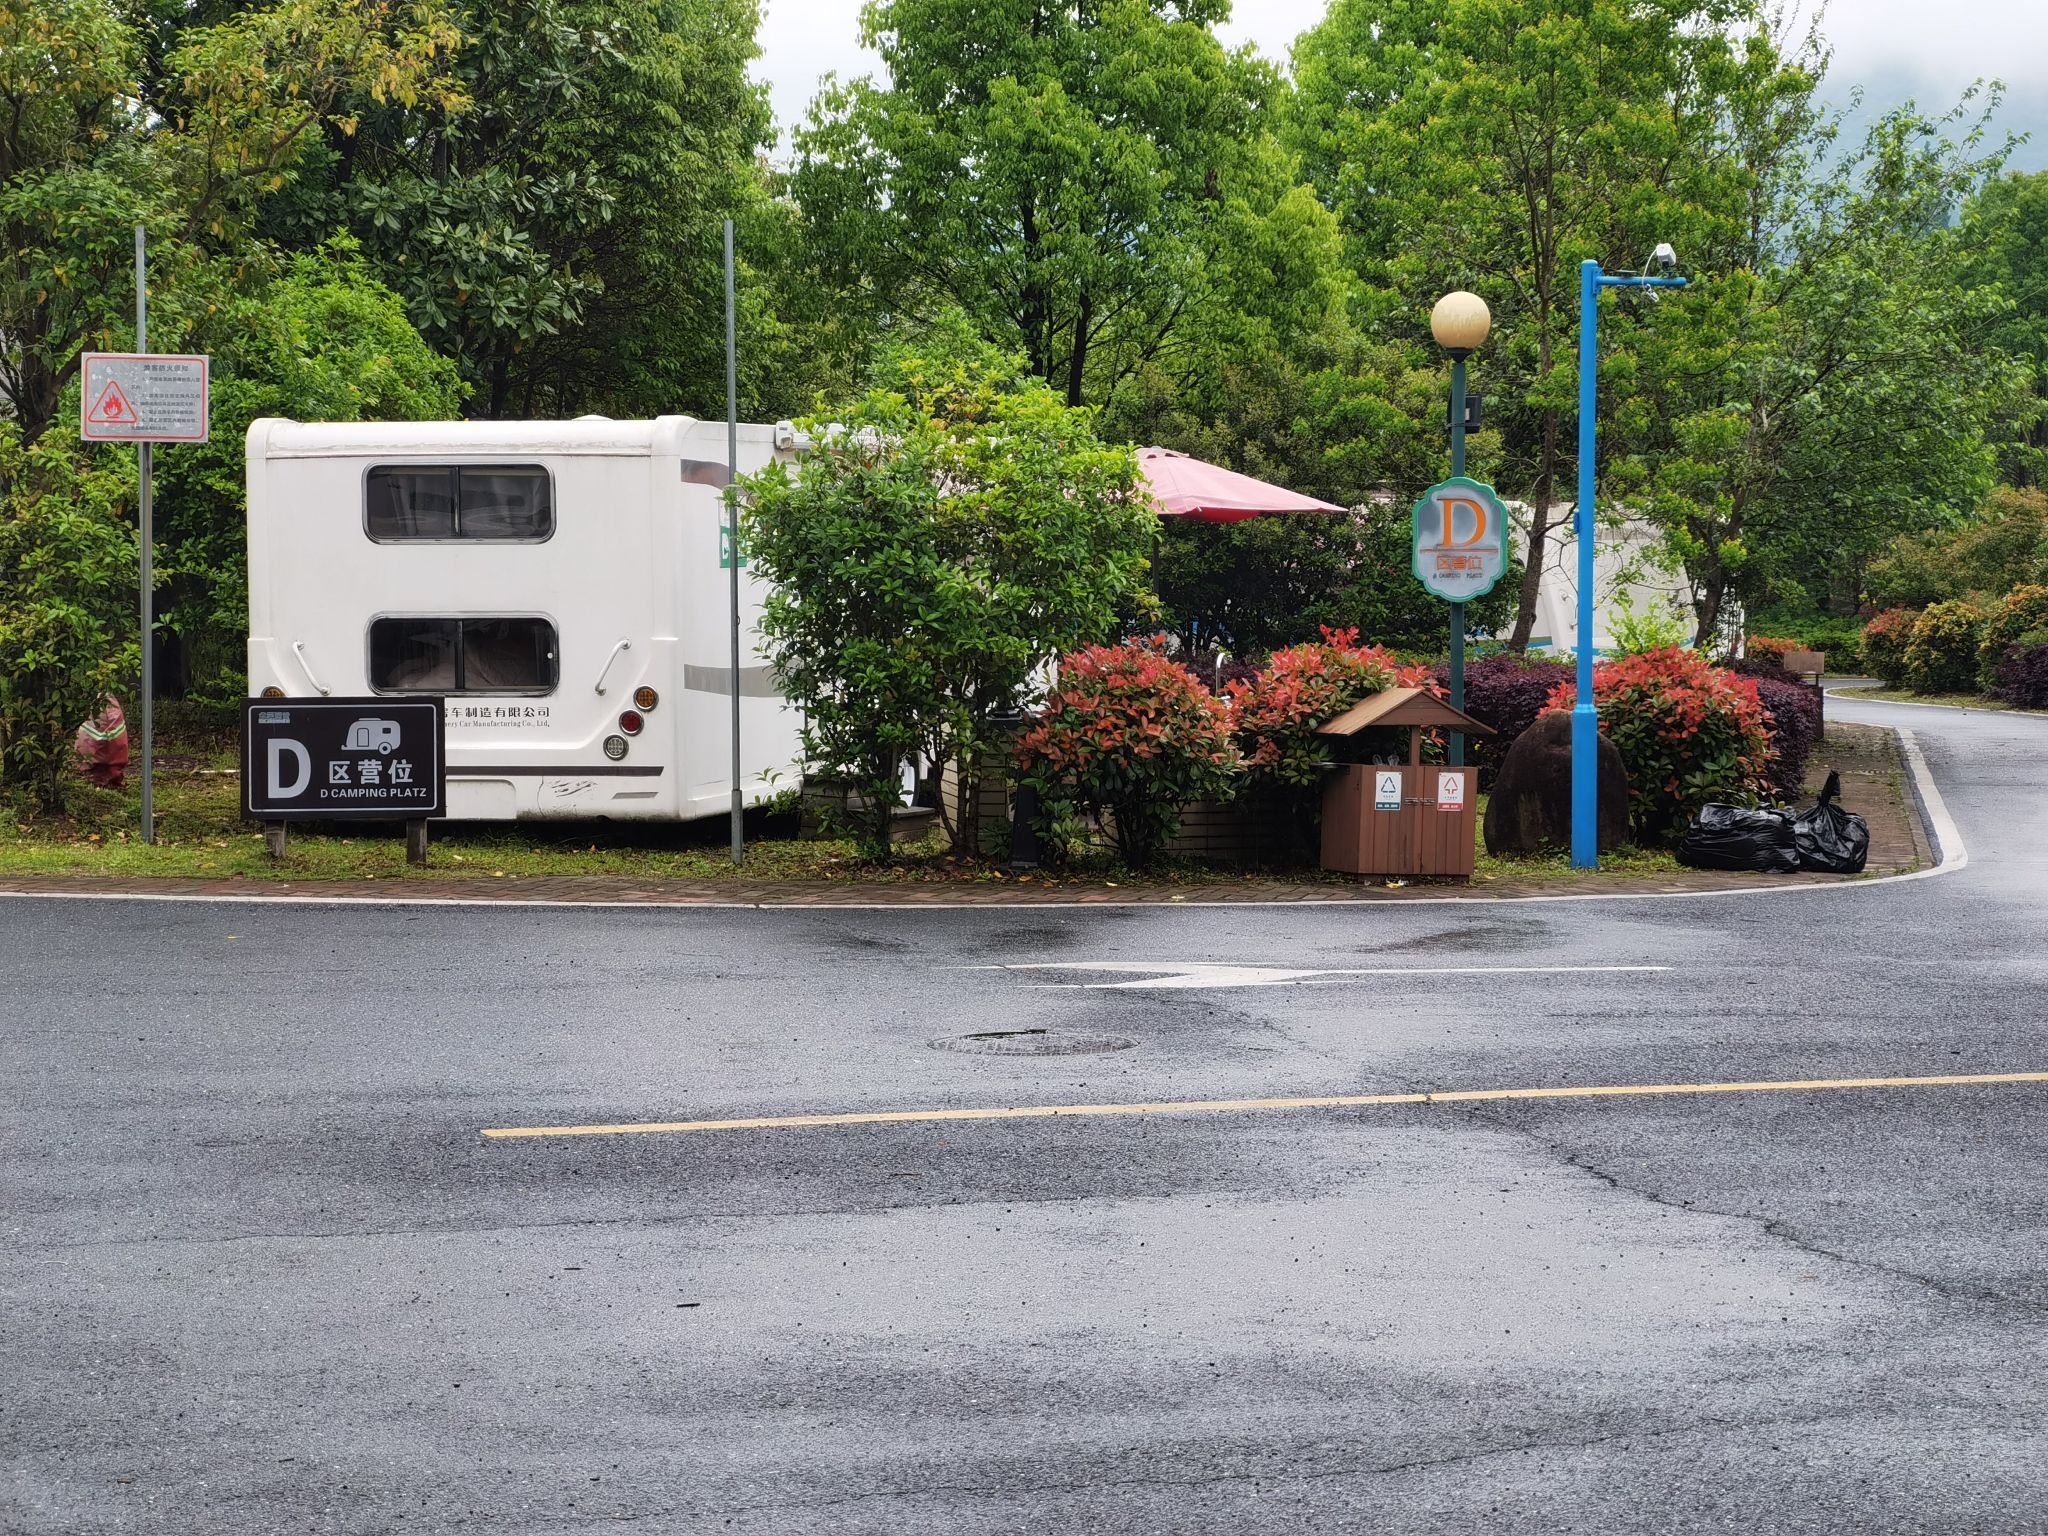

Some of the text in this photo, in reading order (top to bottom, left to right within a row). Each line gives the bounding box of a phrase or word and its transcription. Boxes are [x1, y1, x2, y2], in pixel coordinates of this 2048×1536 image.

[1436, 498, 1487, 548] D
[445, 706, 550, 718] 车制造有限公司
[472, 720, 521, 728] Manufacturing
[267, 738, 312, 799] D
[328, 759, 414, 785] 区营位
[320, 787, 427, 798] D CAMPING PLATZ
